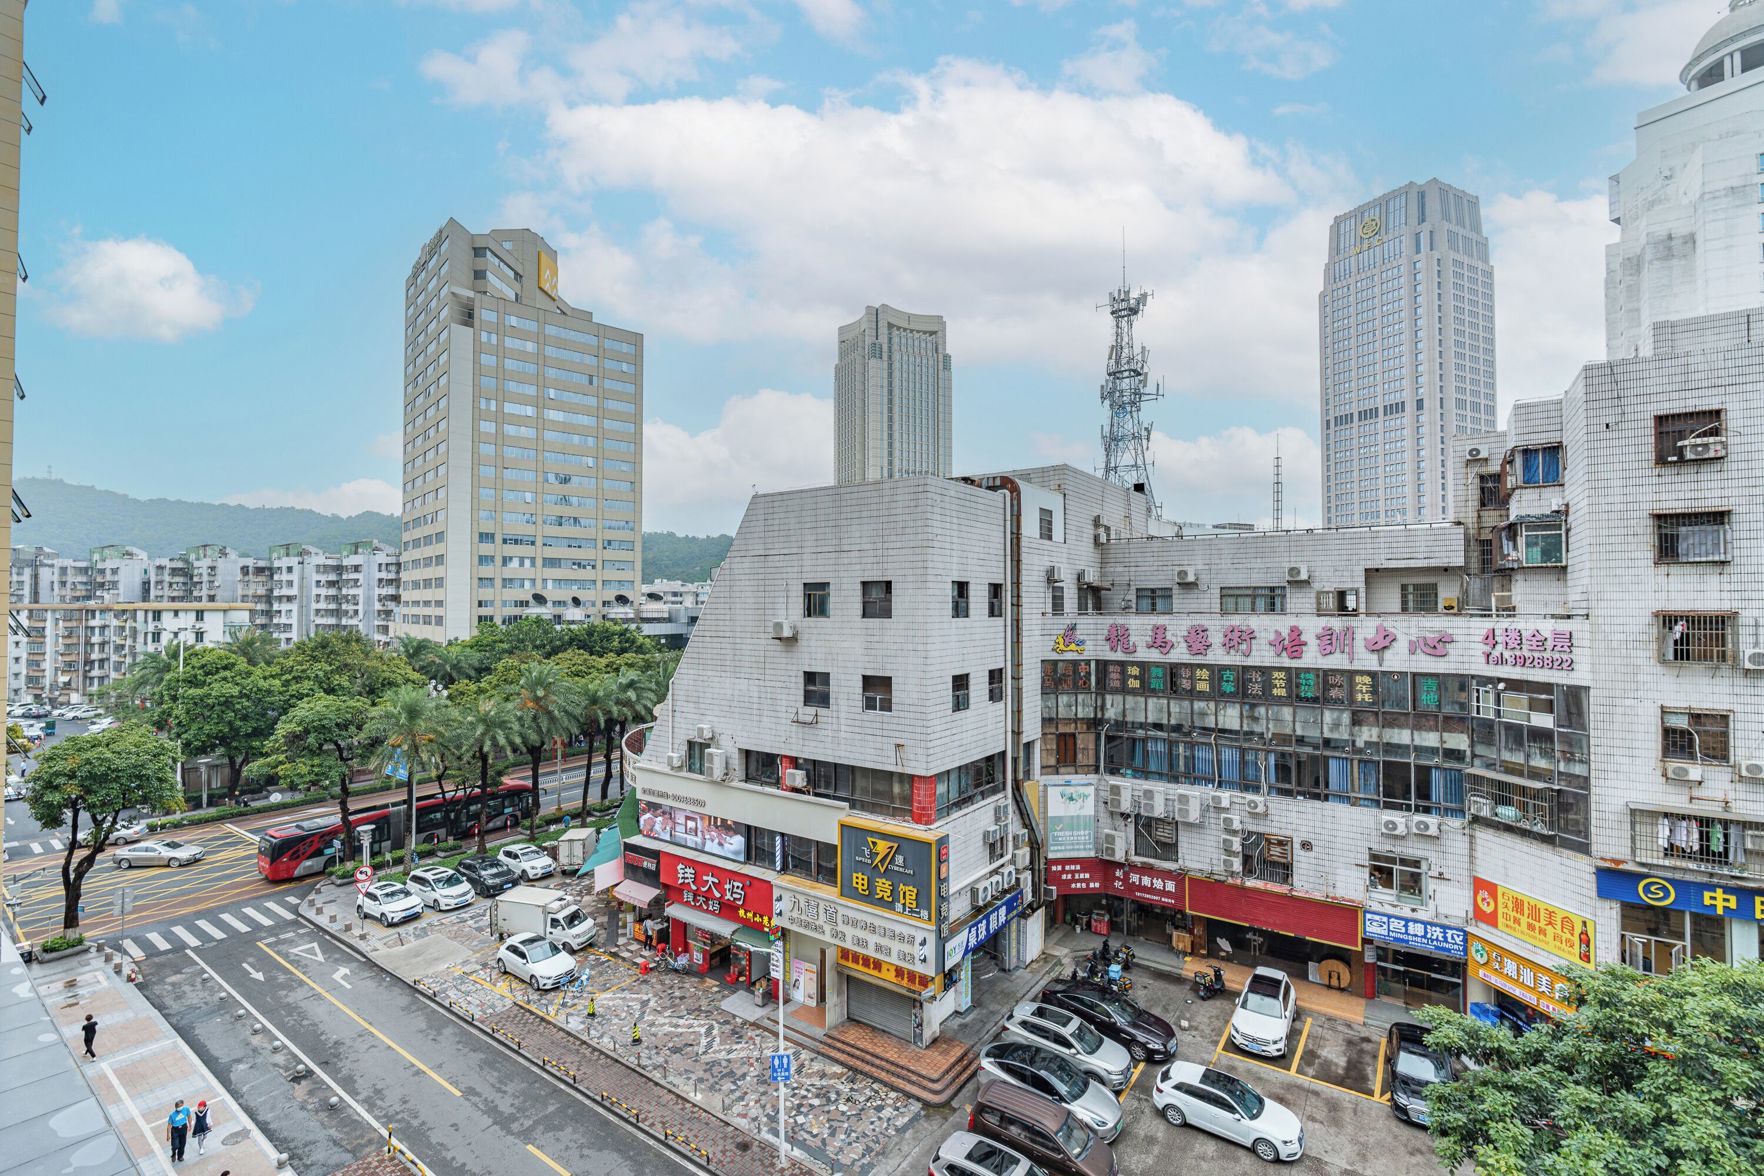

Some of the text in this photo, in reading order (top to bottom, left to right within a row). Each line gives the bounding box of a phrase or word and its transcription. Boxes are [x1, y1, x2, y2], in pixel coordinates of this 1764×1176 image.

[1104, 622, 1454, 666] 龍馬藝術培訓中心
[1481, 627, 1573, 653] 4楼全层
[1127, 665, 1140, 689] 瑜伽
[1195, 668, 1210, 692] 绘画
[1221, 669, 1236, 694] 古筝
[1248, 671, 1262, 695] 书法
[1271, 671, 1287, 697] 双节棍
[1421, 678, 1439, 705] 吉他
[861, 847, 905, 867] 飞 速
[676, 862, 746, 906] 钱大妈
[852, 872, 918, 909] 电竞馆
[1129, 873, 1176, 893] 河南烩面
[683, 889, 721, 914] 钱大妈
[940, 882, 948, 938] 电竞馆
[968, 918, 987, 950] 桌球
[989, 905, 1007, 934] 棋牌
[1502, 912, 1521, 927] 中餐
[1526, 921, 1547, 938] 晚餐
[1511, 895, 1576, 938] 潮汕美食
[1389, 931, 1428, 944] MINGSHEN
[1428, 939, 1464, 951] LAUNDRY
